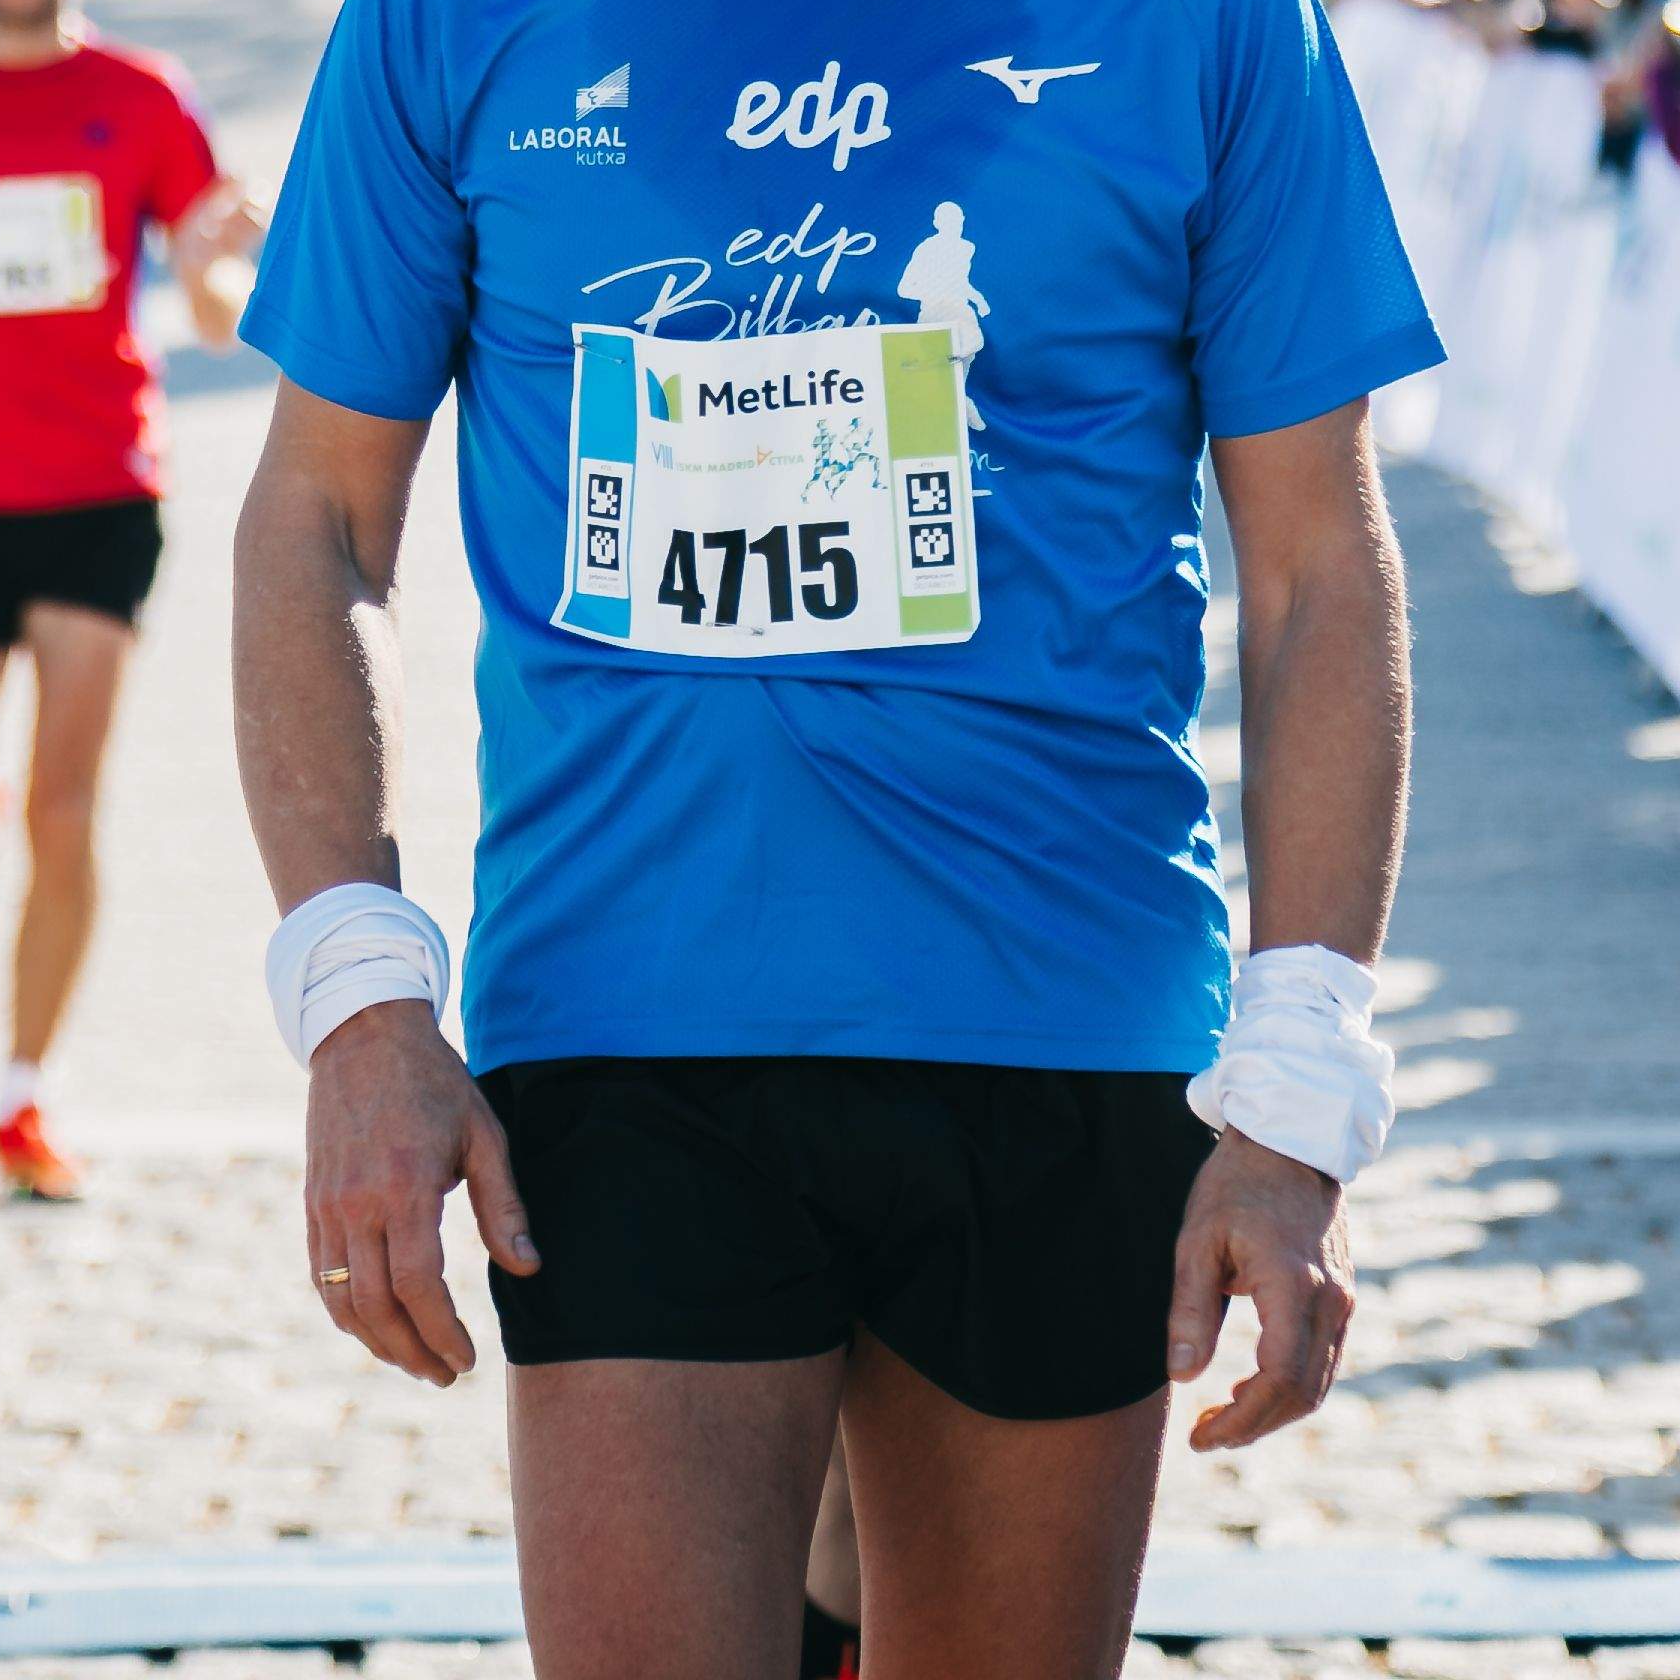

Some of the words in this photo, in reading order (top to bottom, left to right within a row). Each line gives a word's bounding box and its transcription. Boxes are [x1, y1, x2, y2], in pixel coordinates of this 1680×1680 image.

[508, 126, 628, 152] LABORAL
[726, 60, 891, 172] edp
[575, 149, 627, 167] kutxa
[725, 202, 877, 294] edp
[698, 368, 865, 418] MetLife
[707, 460, 756, 474] MADRID
[657, 520, 860, 626] 4715
